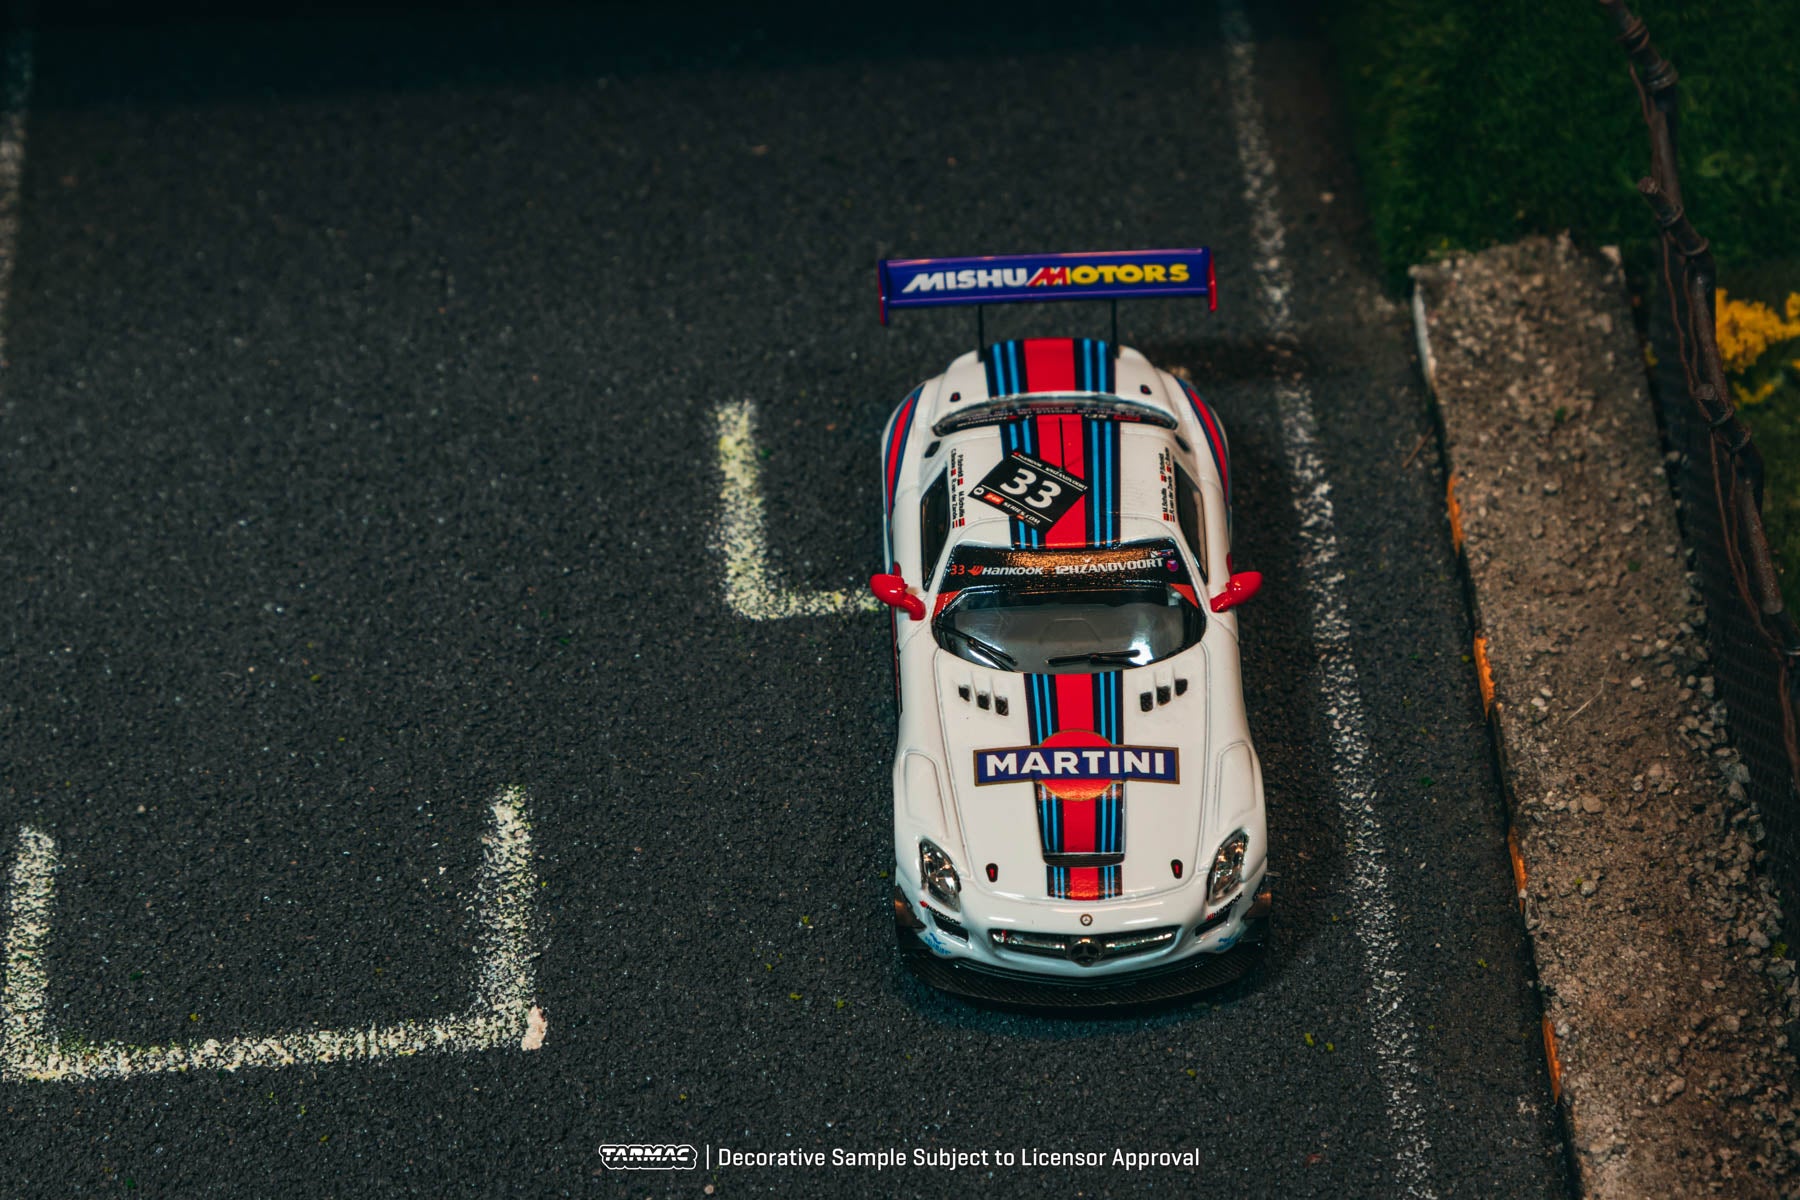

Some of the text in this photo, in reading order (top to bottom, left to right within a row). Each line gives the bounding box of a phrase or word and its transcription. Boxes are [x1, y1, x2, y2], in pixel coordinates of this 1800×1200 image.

[902, 264, 1190, 293] MISHU MOTORS
[1000, 468, 1062, 508] 33
[950, 564, 965, 576] 33
[986, 750, 1166, 777] MARTINI
